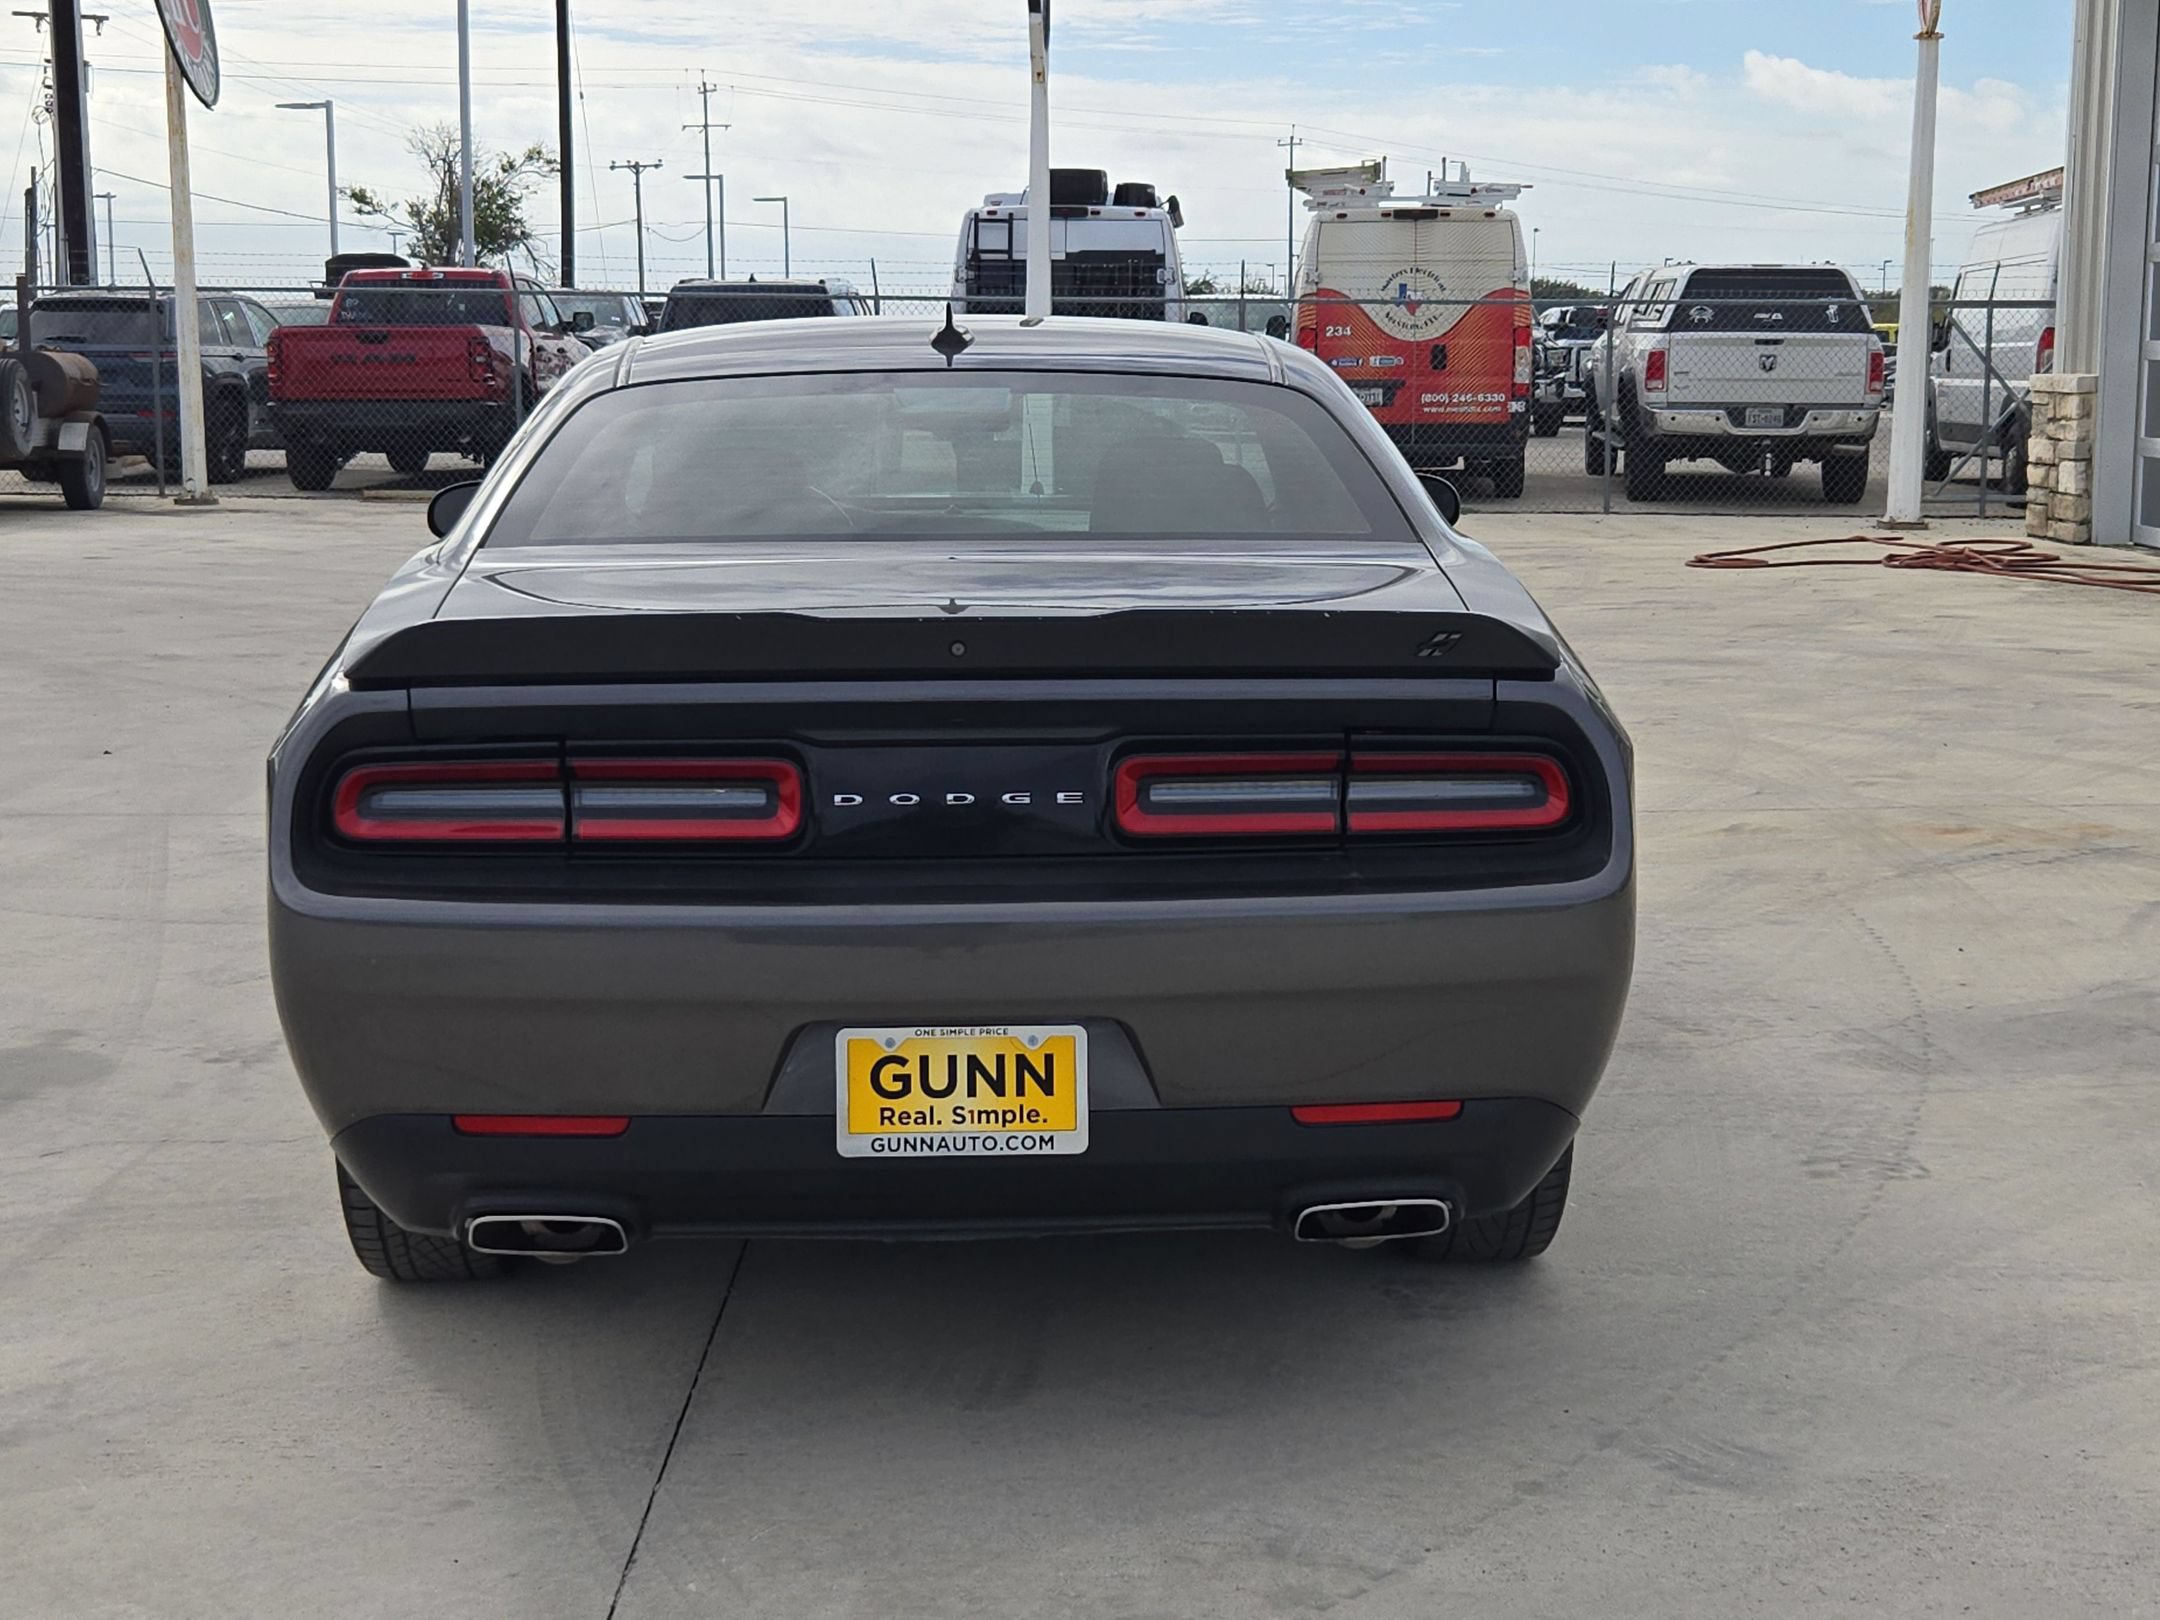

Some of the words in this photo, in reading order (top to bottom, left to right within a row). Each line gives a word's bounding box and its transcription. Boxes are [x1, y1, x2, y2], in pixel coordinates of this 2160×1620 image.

[1325, 325, 1352, 337] 234
[833, 792, 1084, 806] DODGE
[914, 1028, 937, 1037] ONE
[940, 1027, 976, 1036] SIMPLE
[979, 1027, 1009, 1036] PRICE
[869, 1052, 1055, 1101] GUNN
[879, 1105, 943, 1127] Real.
[870, 1134, 1055, 1154] GUNNAUTO.COM
